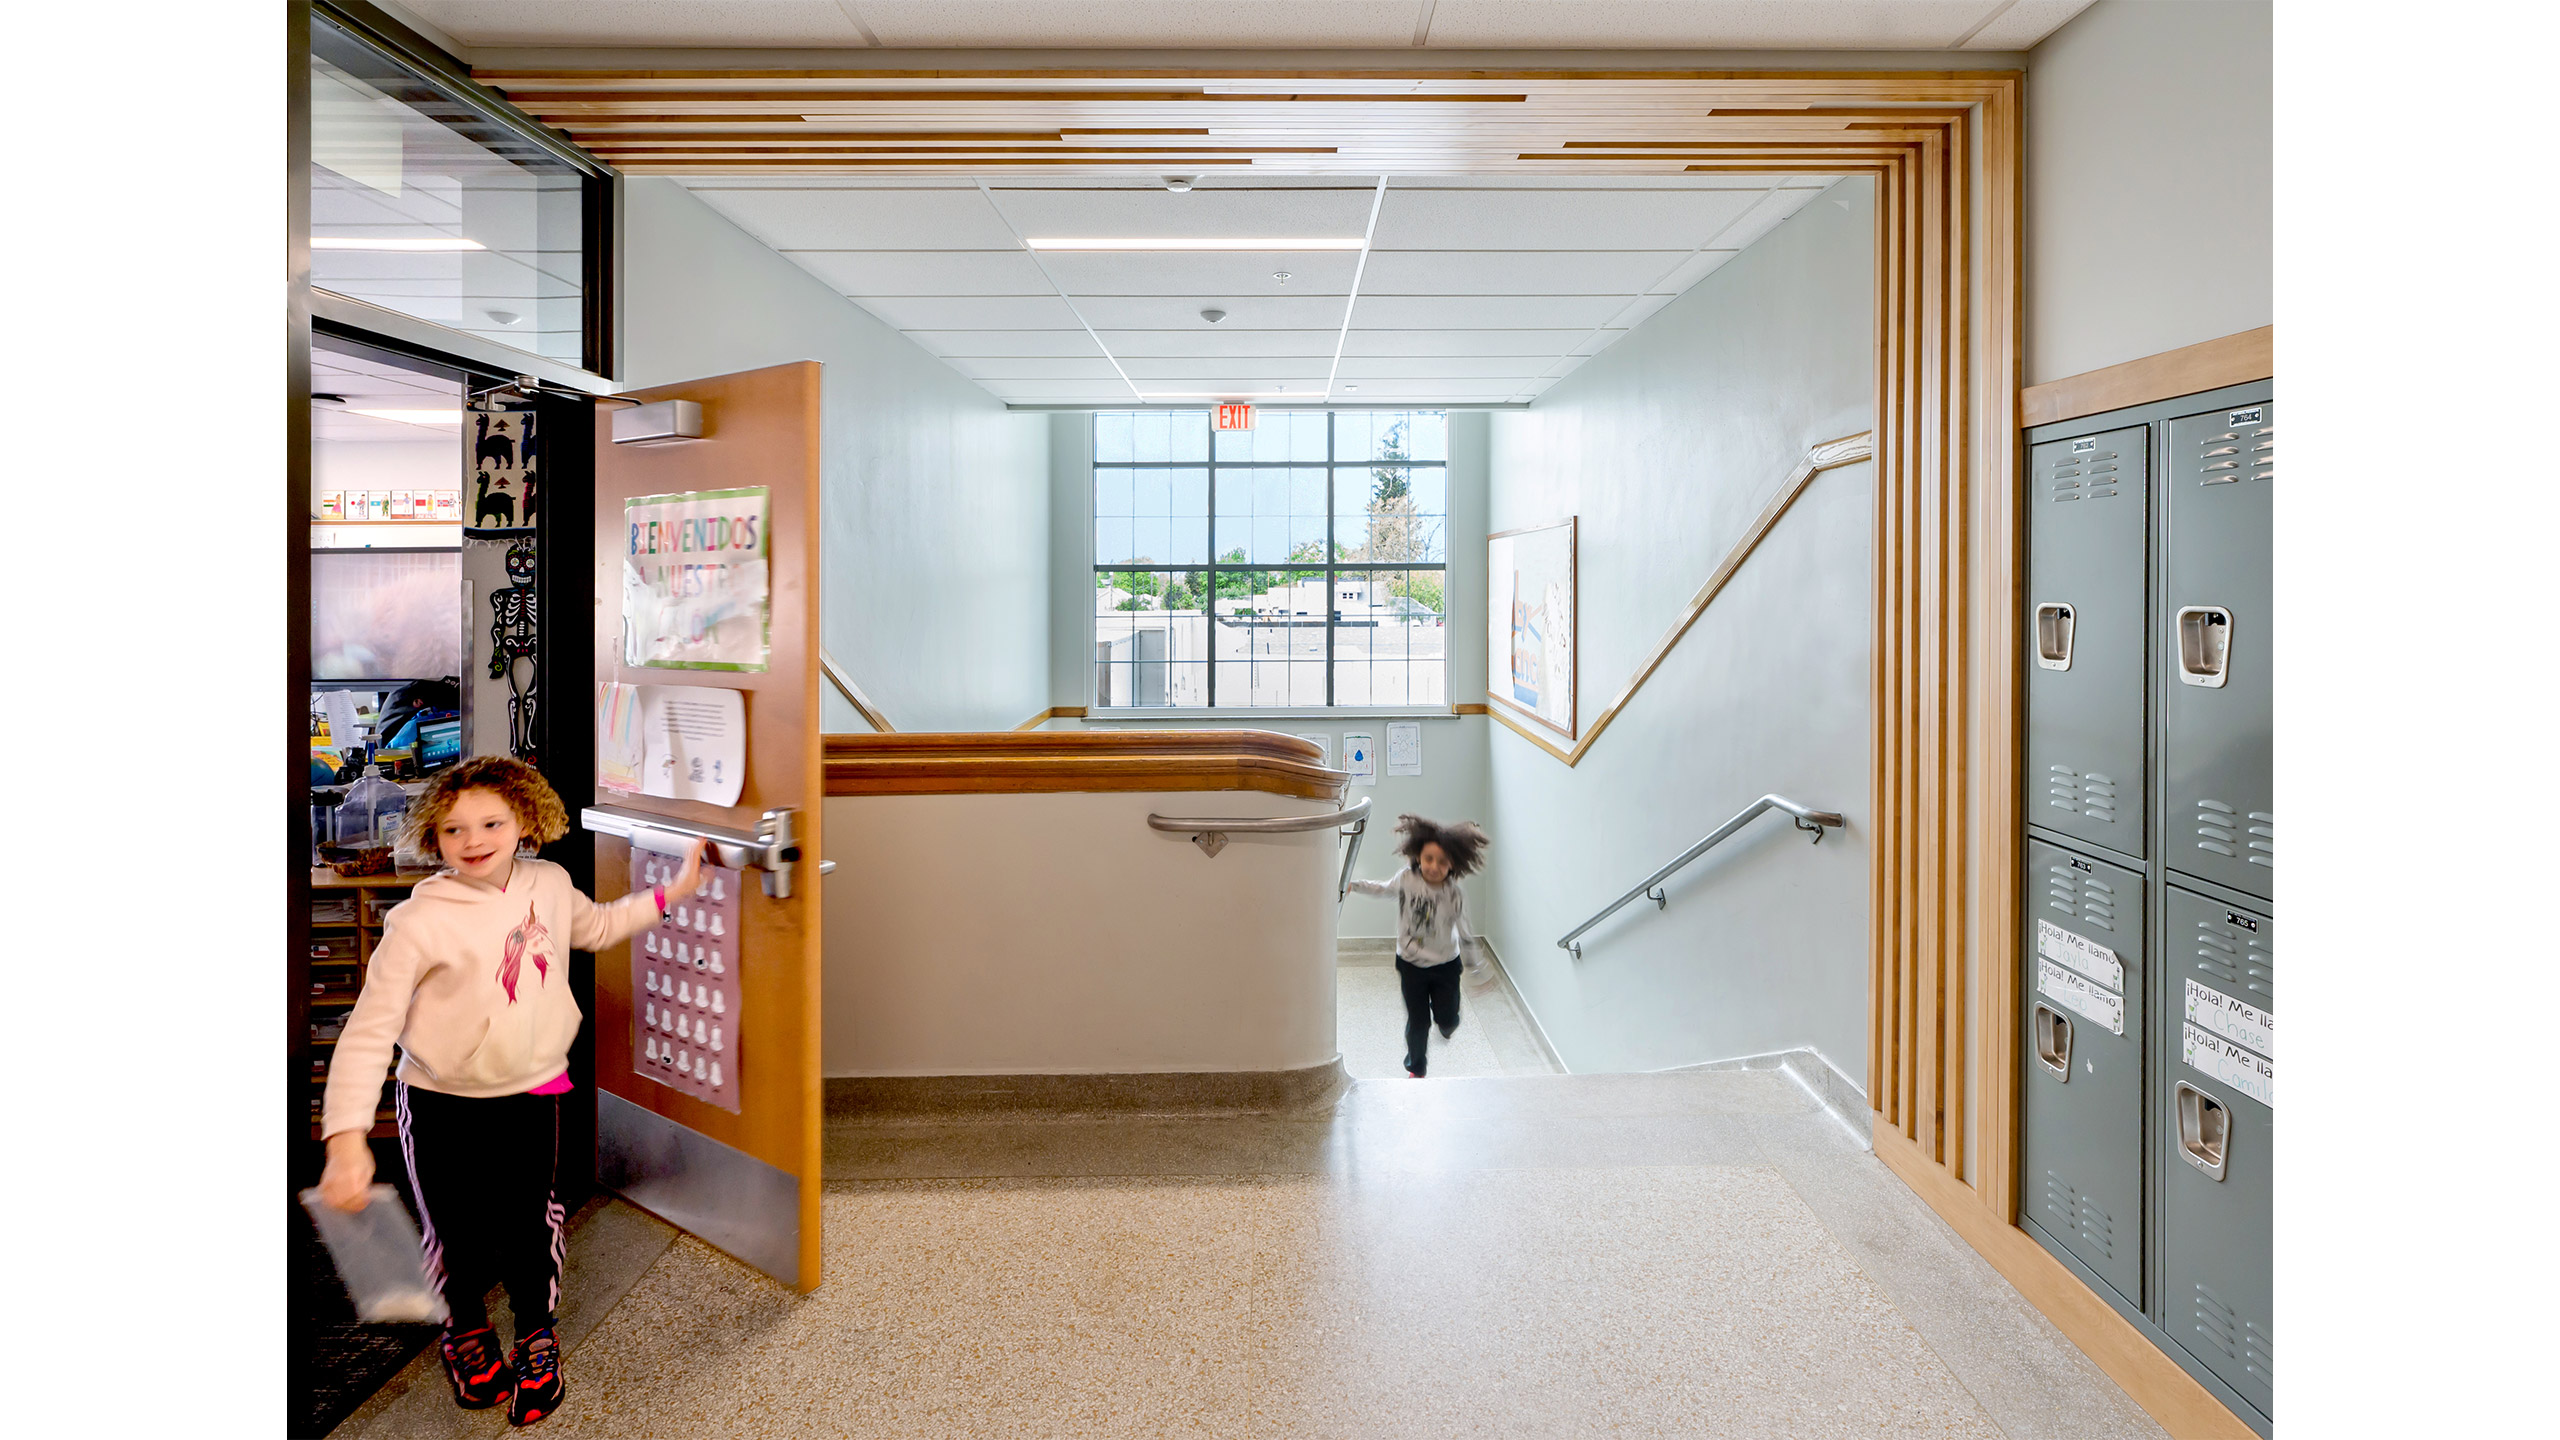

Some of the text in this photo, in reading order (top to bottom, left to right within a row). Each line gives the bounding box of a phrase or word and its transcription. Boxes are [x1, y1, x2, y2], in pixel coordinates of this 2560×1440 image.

[1219, 404, 1250, 429] EXIT
[631, 514, 758, 555] BIENVENIDOS
[2038, 922, 2064, 942] ¡Hola!
[2066, 934, 2085, 951] Me
[2236, 916, 2249, 927] 765
[2039, 961, 2116, 1008] ¡Hola! Me llamo
[2186, 983, 2223, 1008] ¡Hola!
[2228, 1000, 2254, 1021] Me
[2184, 1027, 2220, 1053] ¡Hola!
[2225, 1046, 2251, 1068] Me
[2213, 1009, 2265, 1049] Chase
